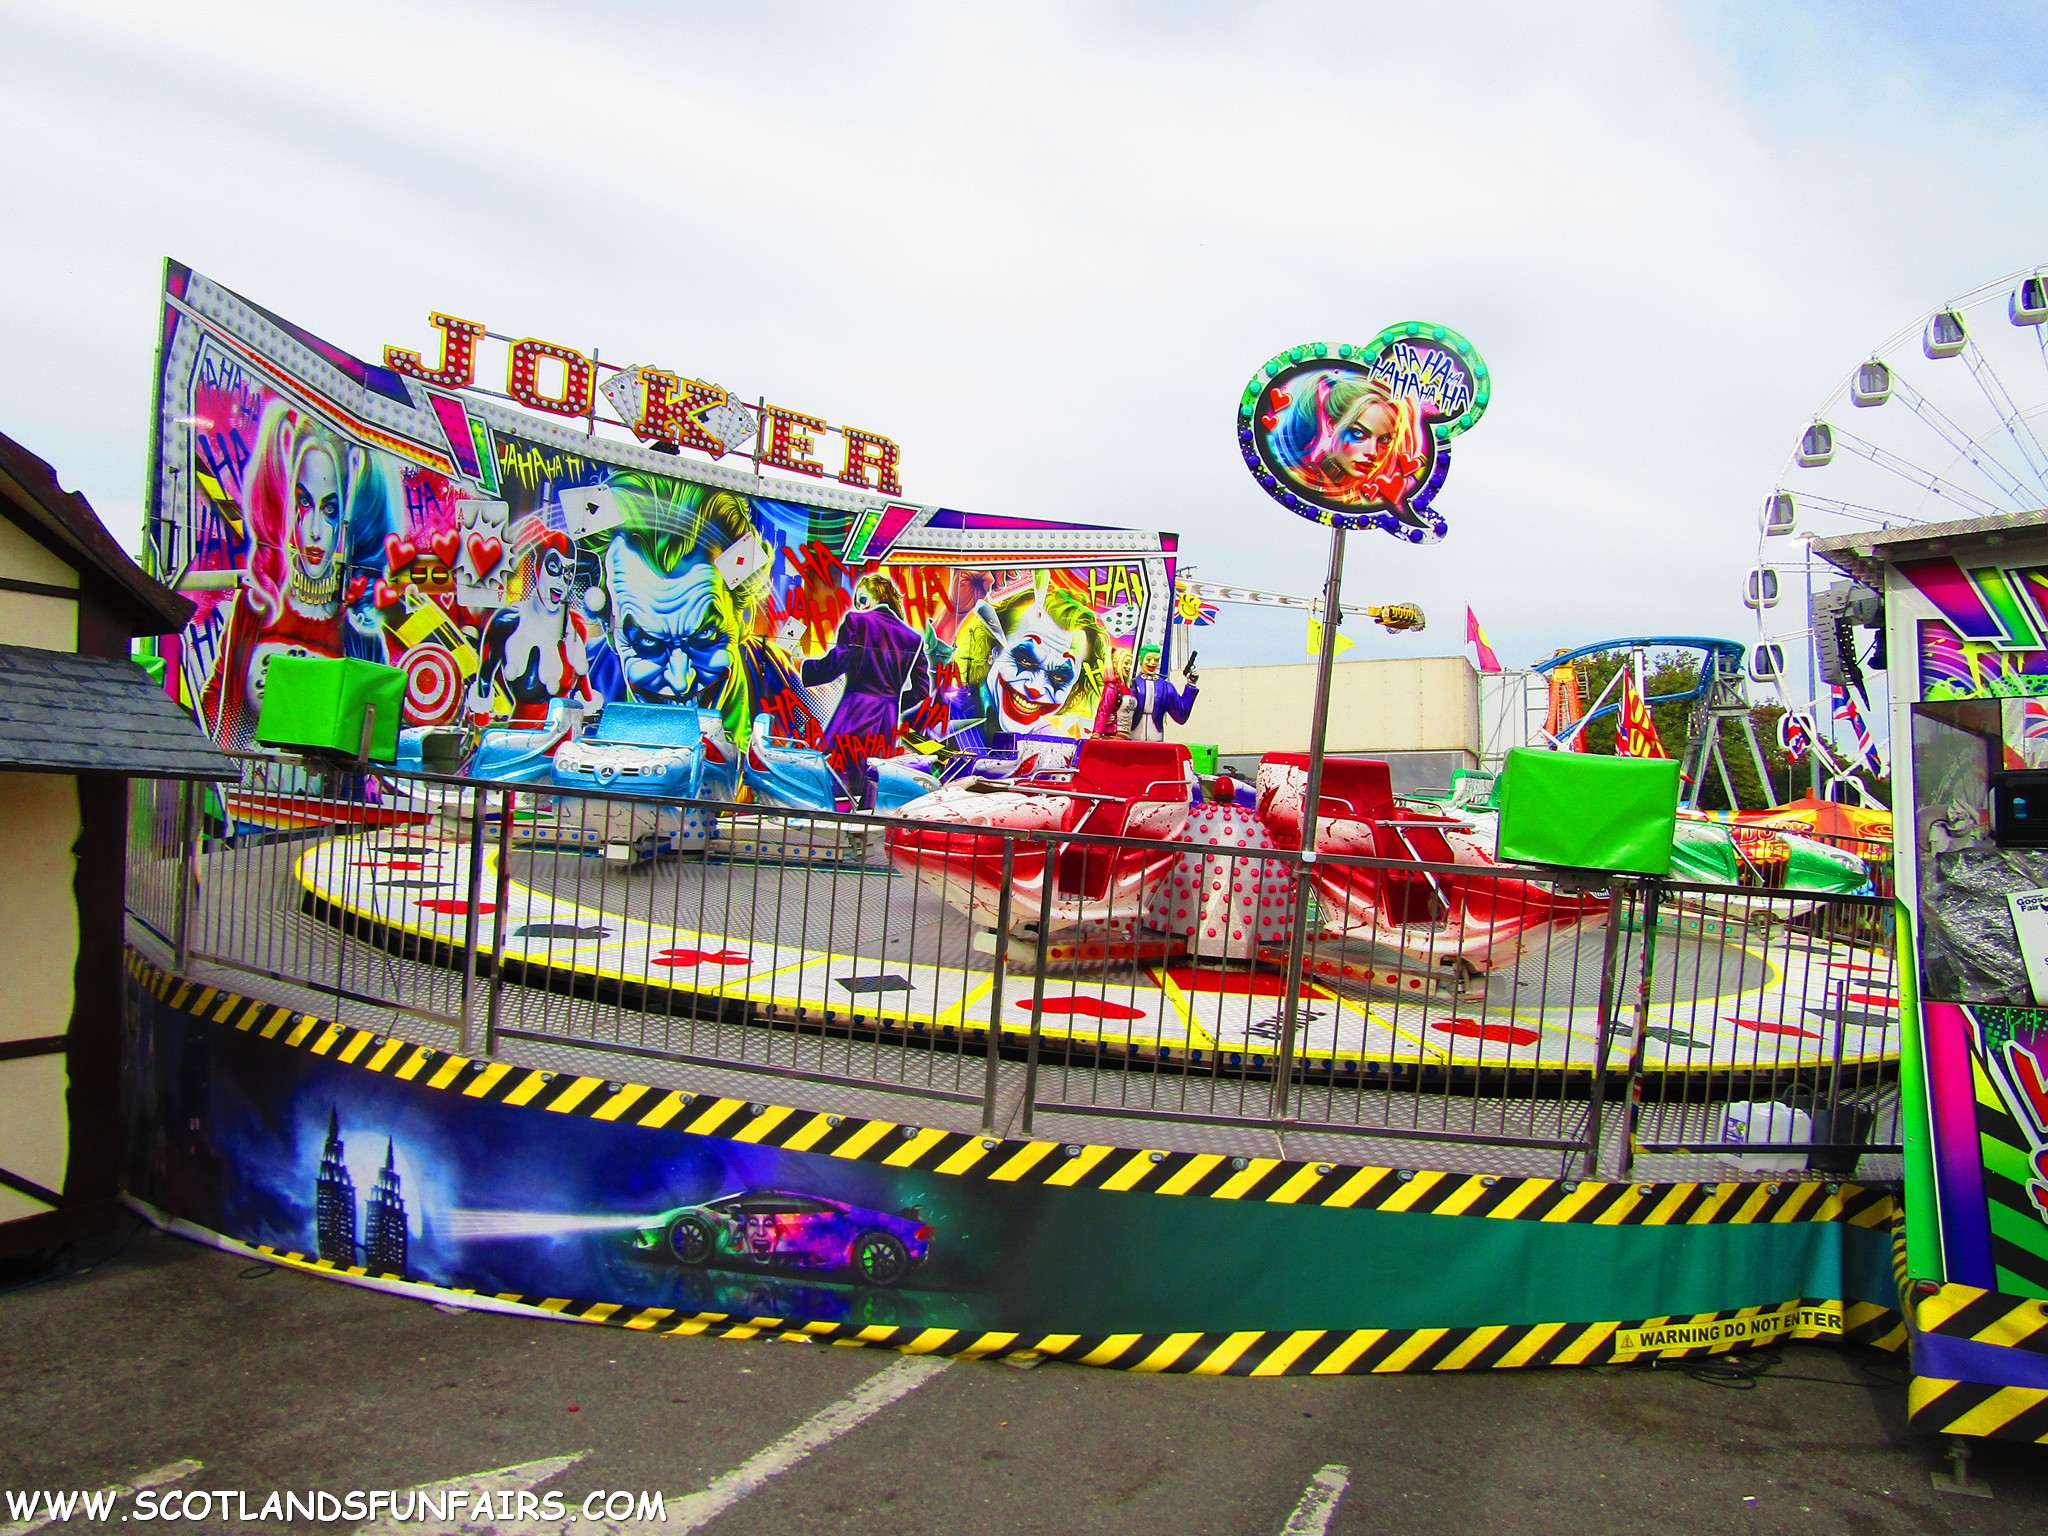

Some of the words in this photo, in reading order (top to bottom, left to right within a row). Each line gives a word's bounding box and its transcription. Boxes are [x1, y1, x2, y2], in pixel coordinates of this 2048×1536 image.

[1370, 357, 1397, 384] HA
[1392, 371, 1421, 401] HA
[1421, 386, 1436, 401] HA
[1442, 383, 1469, 412] HA
[1394, 344, 1421, 371] HA
[1422, 351, 1452, 392] HA
[383, 310, 902, 497] JOKER
[405, 481, 446, 531] HA
[782, 540, 850, 593] HA
[936, 661, 963, 693] HA
[760, 687, 812, 735] HA
[913, 696, 950, 736] HA
[1640, 1325, 1720, 1347] WARNING
[1724, 1323, 1746, 1338] DO
[1751, 1318, 1780, 1334] NOT
[1784, 1311, 1842, 1331] ENTER
